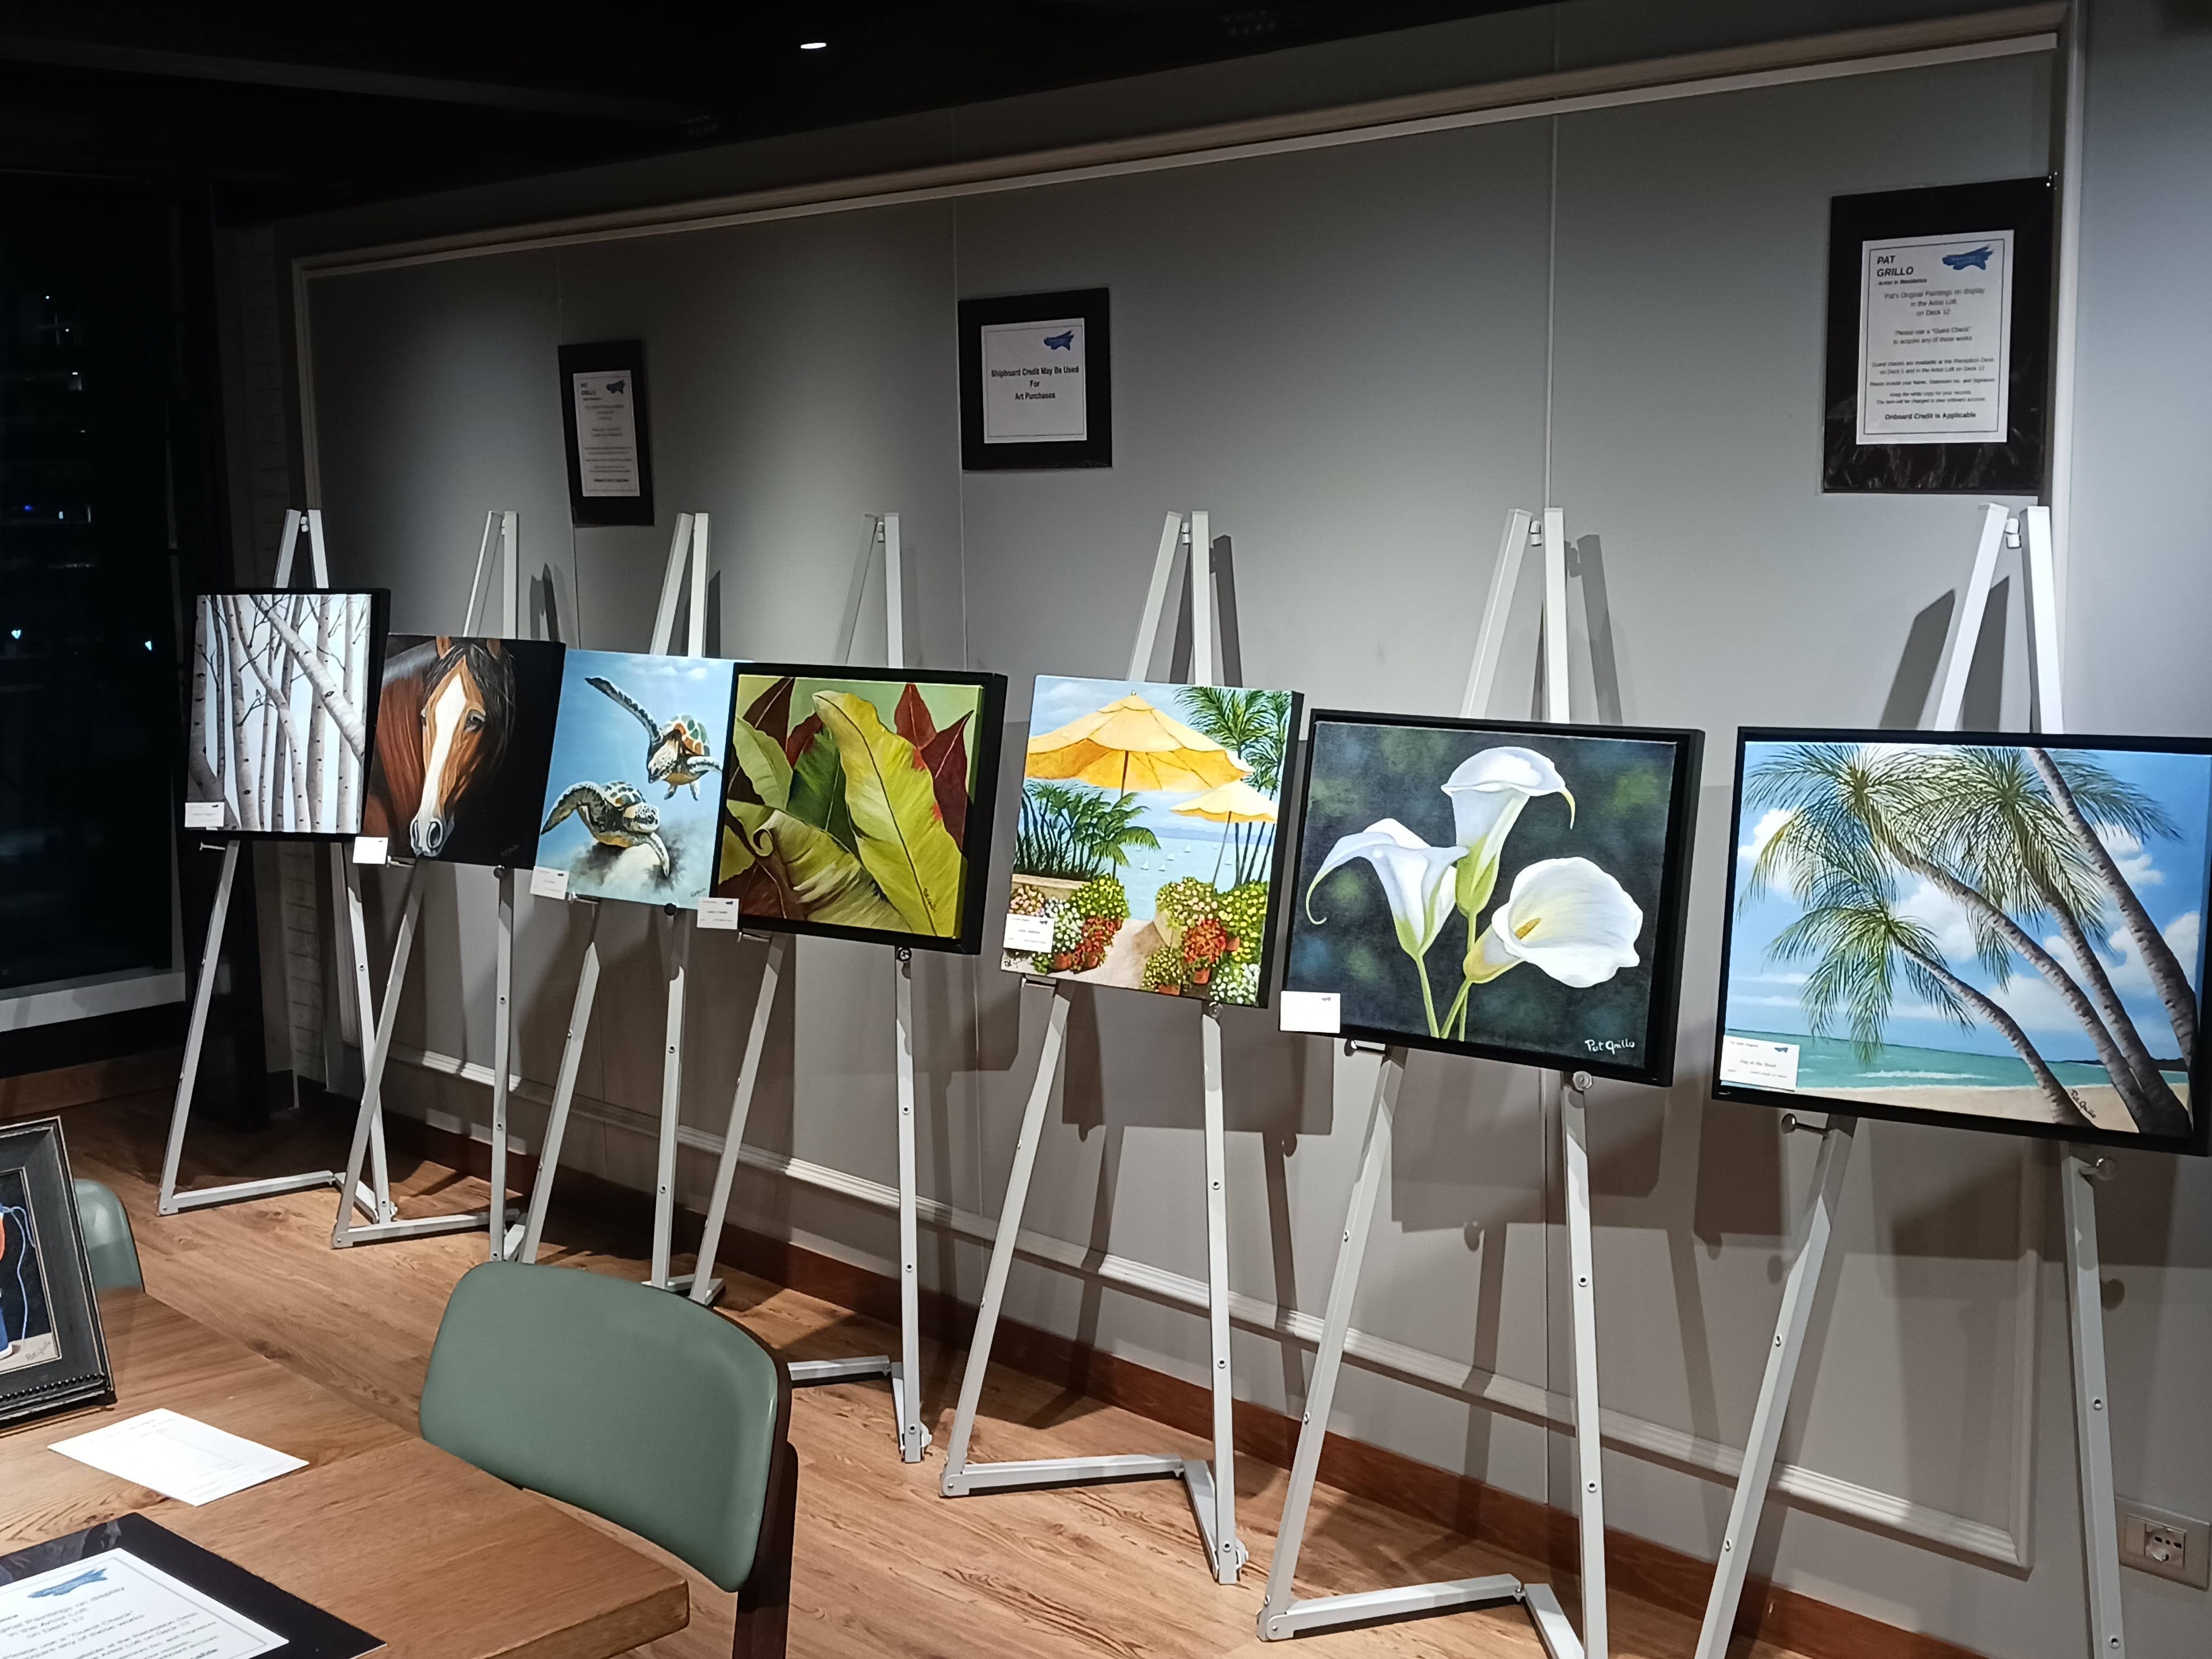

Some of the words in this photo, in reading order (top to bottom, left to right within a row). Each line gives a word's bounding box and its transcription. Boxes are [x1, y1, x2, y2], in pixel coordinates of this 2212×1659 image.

[1877, 255, 1895, 264] PAT
[1877, 267, 1914, 276] GRILLO
[991, 369, 1021, 378] Shipboard
[1041, 367, 1052, 376] May
[1030, 380, 1040, 388] For
[1584, 1039, 1604, 1052] Pat
